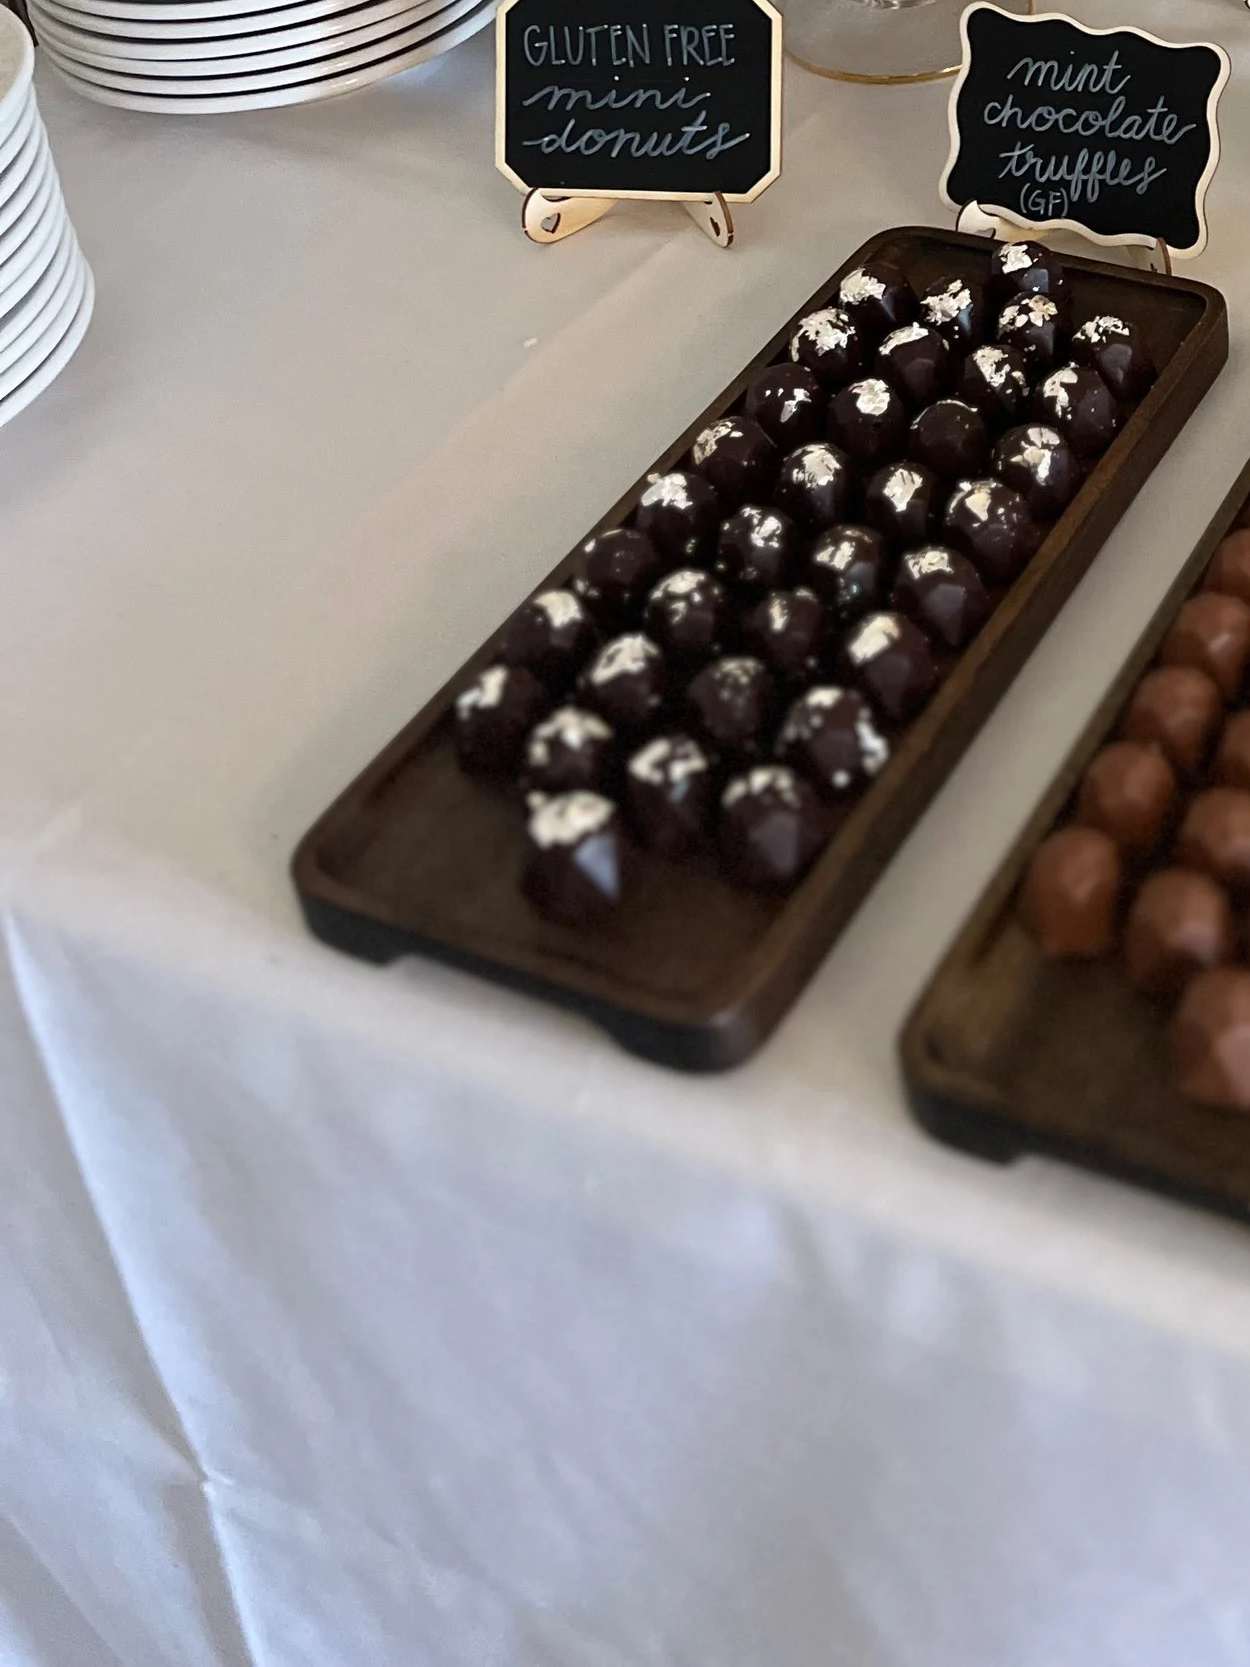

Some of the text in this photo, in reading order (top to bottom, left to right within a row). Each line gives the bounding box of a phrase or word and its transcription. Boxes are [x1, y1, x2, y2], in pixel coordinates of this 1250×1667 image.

[523, 23, 735, 67] GLUTEN FREE
[522, 76, 711, 110] mini
[1007, 50, 1131, 94] mint
[522, 110, 750, 160] donuts
[984, 94, 1197, 144] chocolate
[998, 141, 1167, 202] truffles
[1020, 183, 1069, 217] (GF)
